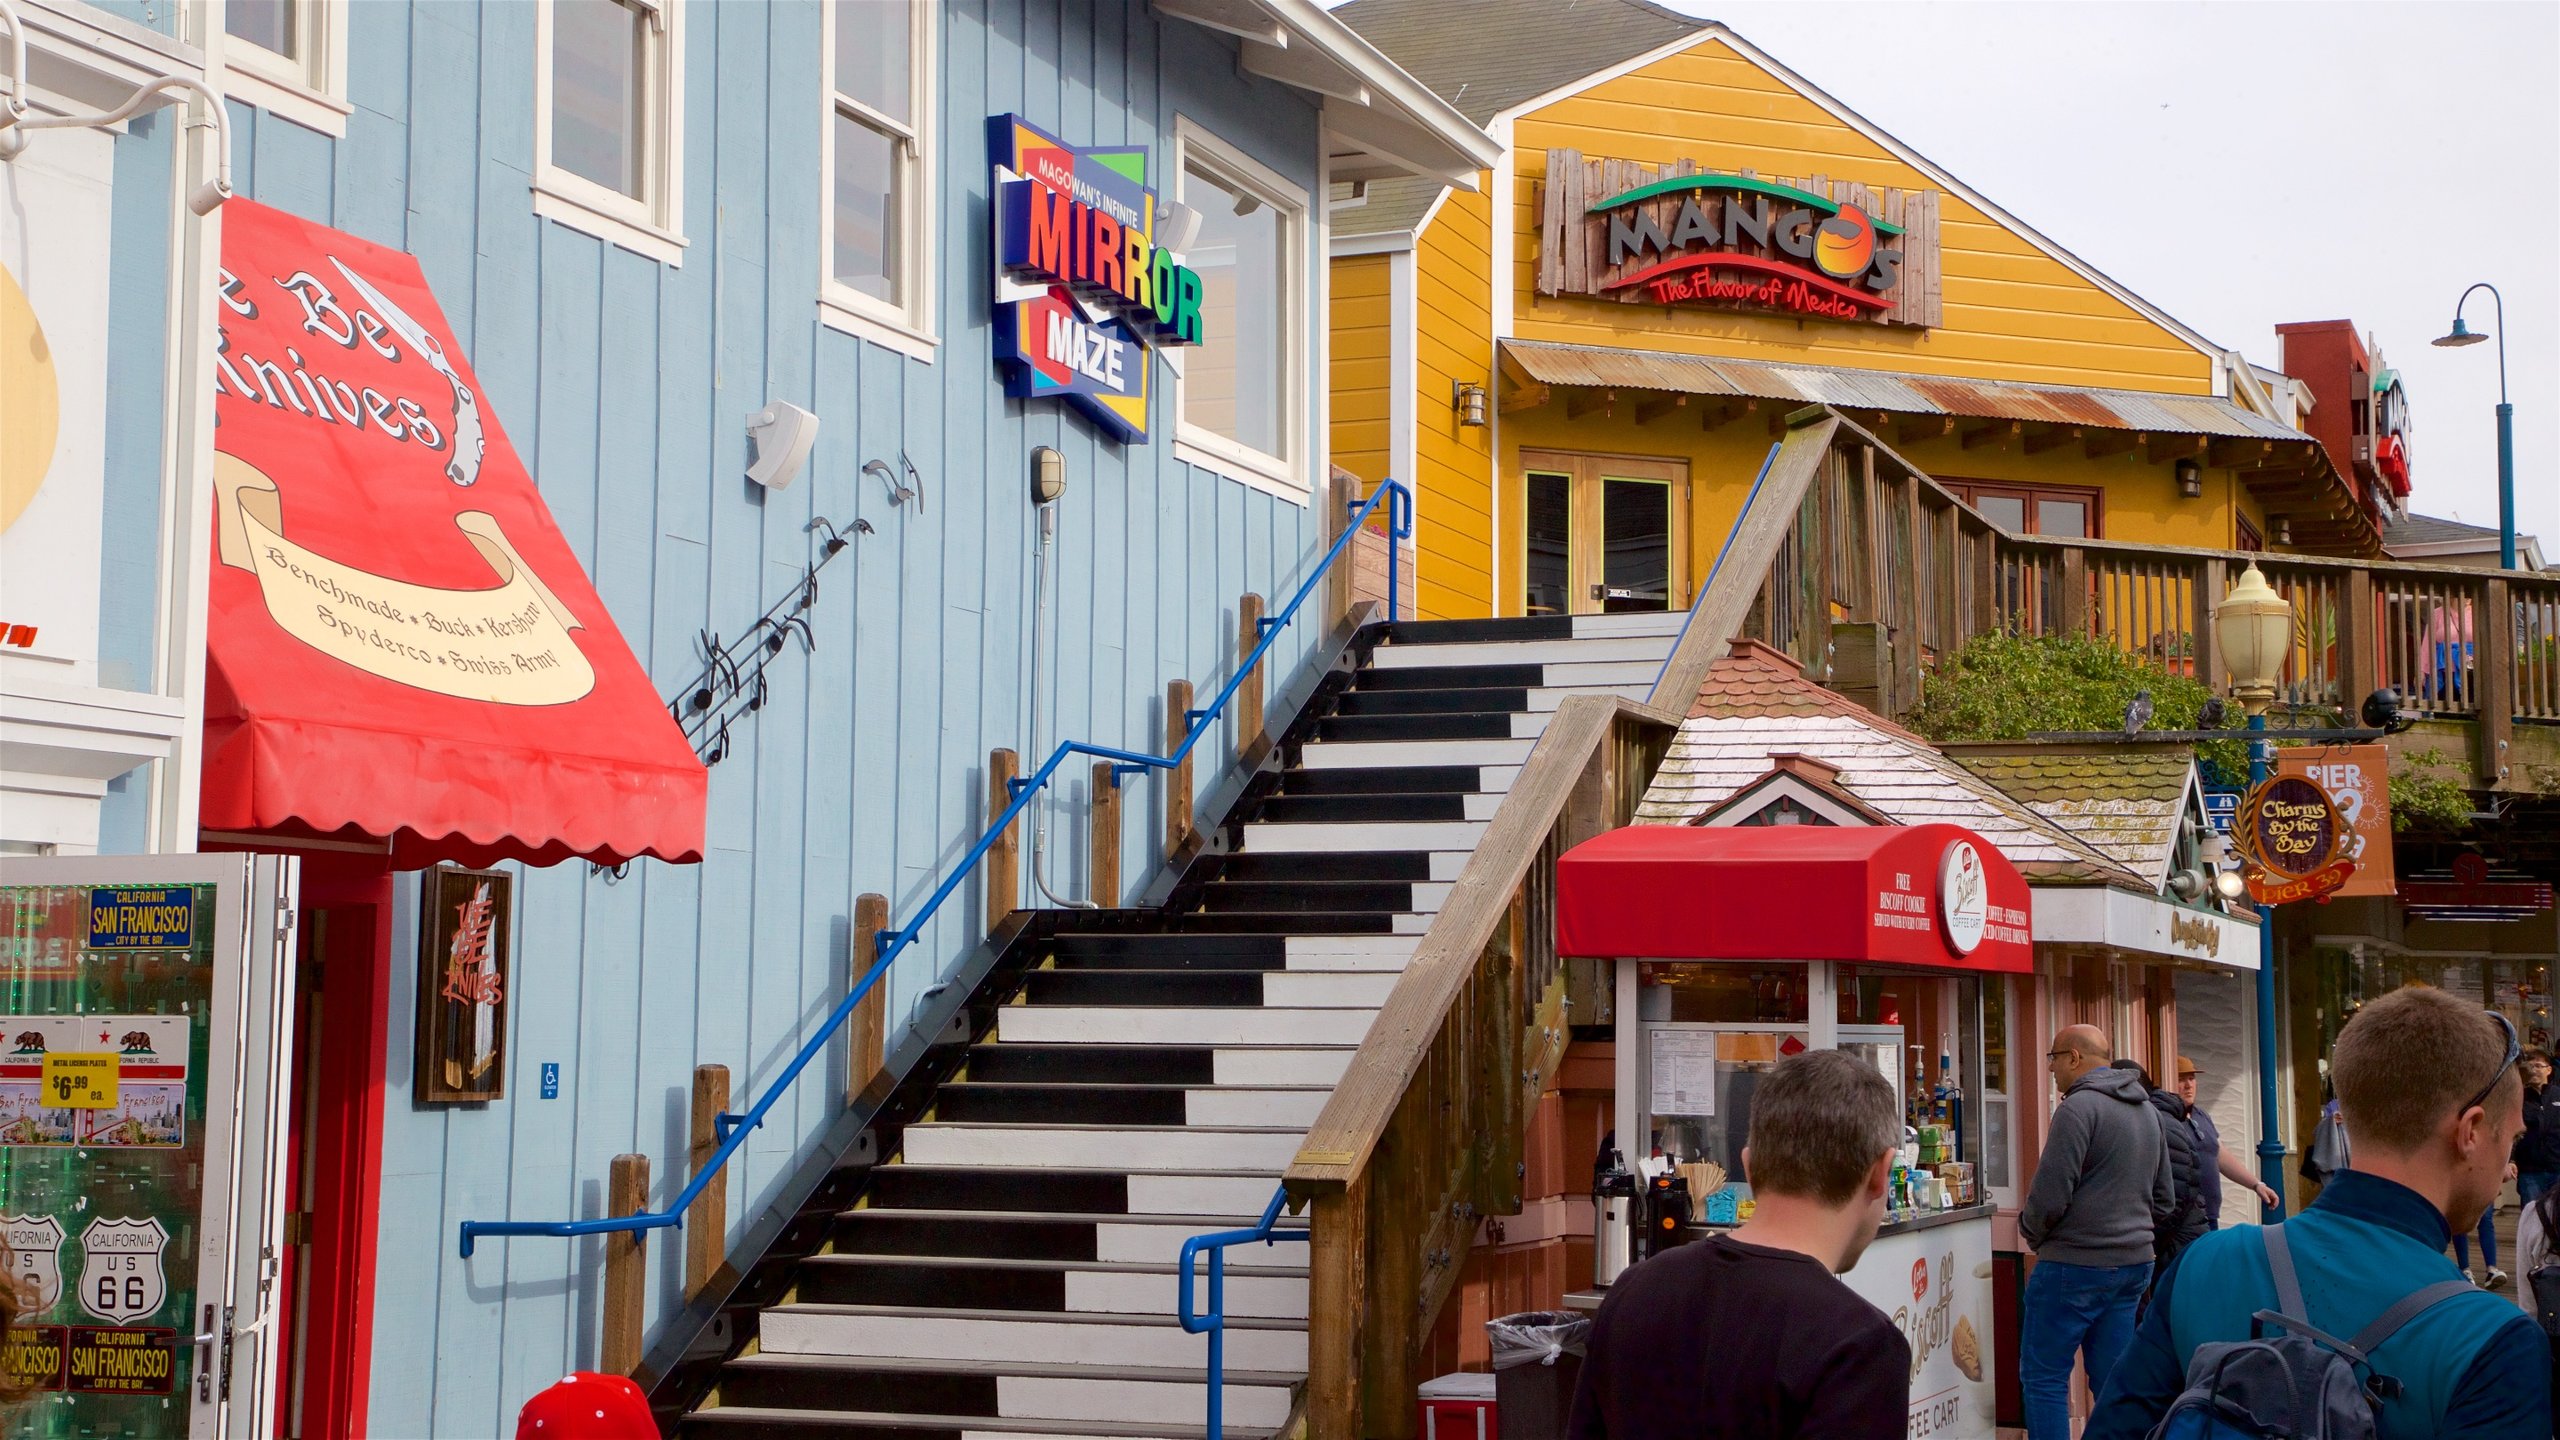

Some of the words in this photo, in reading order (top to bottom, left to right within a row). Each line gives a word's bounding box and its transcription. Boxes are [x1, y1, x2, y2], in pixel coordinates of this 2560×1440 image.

[1038, 156, 1101, 208] MAGOWAN'S
[1103, 195, 1138, 229] INFINITE
[1028, 178, 1204, 347] MIRROR
[1650, 272, 1695, 304] The
[1692, 266, 1754, 301] Flavor
[1759, 278, 1783, 304] of
[1787, 281, 1858, 321] Mexico
[272, 270, 402, 364] Be
[1047, 309, 1125, 393] MAZE
[263, 544, 405, 625] Benchmade
[420, 611, 473, 638] Buck
[316, 604, 433, 664] Spyderco
[448, 650, 511, 676] Swiss
[511, 649, 561, 674] Army
[2305, 764, 2362, 789] PIER
[2261, 800, 2327, 819] Charms
[2268, 820, 2295, 836] By
[2295, 818, 2320, 832] the
[2275, 835, 2317, 854] Bay
[1896, 873, 1911, 891] FREE
[2316, 870, 2342, 889] 39
[116, 891, 166, 903] CALIFORNIA
[1880, 892, 1904, 911] BISCOFF
[1904, 895, 1926, 913] COOKIE
[93, 907, 116, 934] SAN
[119, 906, 188, 934] FRANCISCO
[1874, 912, 1891, 927] SERVED
[1916, 917, 1931, 931] COFFEE
[1952, 917, 1970, 929] COFFEE
[1970, 918, 1982, 929] CART
[2006, 908, 2027, 926] ESPRESSO
[115, 935, 129, 945] CITY
[130, 936, 139, 945] BY
[140, 936, 150, 945] THE
[152, 936, 164, 945] BAY
[1995, 925, 2012, 943] COFFEE
[2012, 928, 2029, 945] DRINKS
[442, 965, 503, 1006] KNIVES
[53, 1075, 88, 1101] $6.99
[91, 1091, 104, 1101] ea.
[92, 1233, 154, 1248] CALIFORNIA
[98, 1276, 144, 1309] 66
[95, 1332, 146, 1345] CALIFORNIA
[72, 1347, 96, 1376] SAN
[100, 1349, 169, 1378] FRANCISCO
[94, 1378, 108, 1388] CITY
[108, 1379, 118, 1388] BY
[119, 1379, 130, 1388] THE
[131, 1379, 144, 1389] BAY
[1908, 1408, 1930, 1438] FEE
[1933, 1396, 1960, 1429] CART
